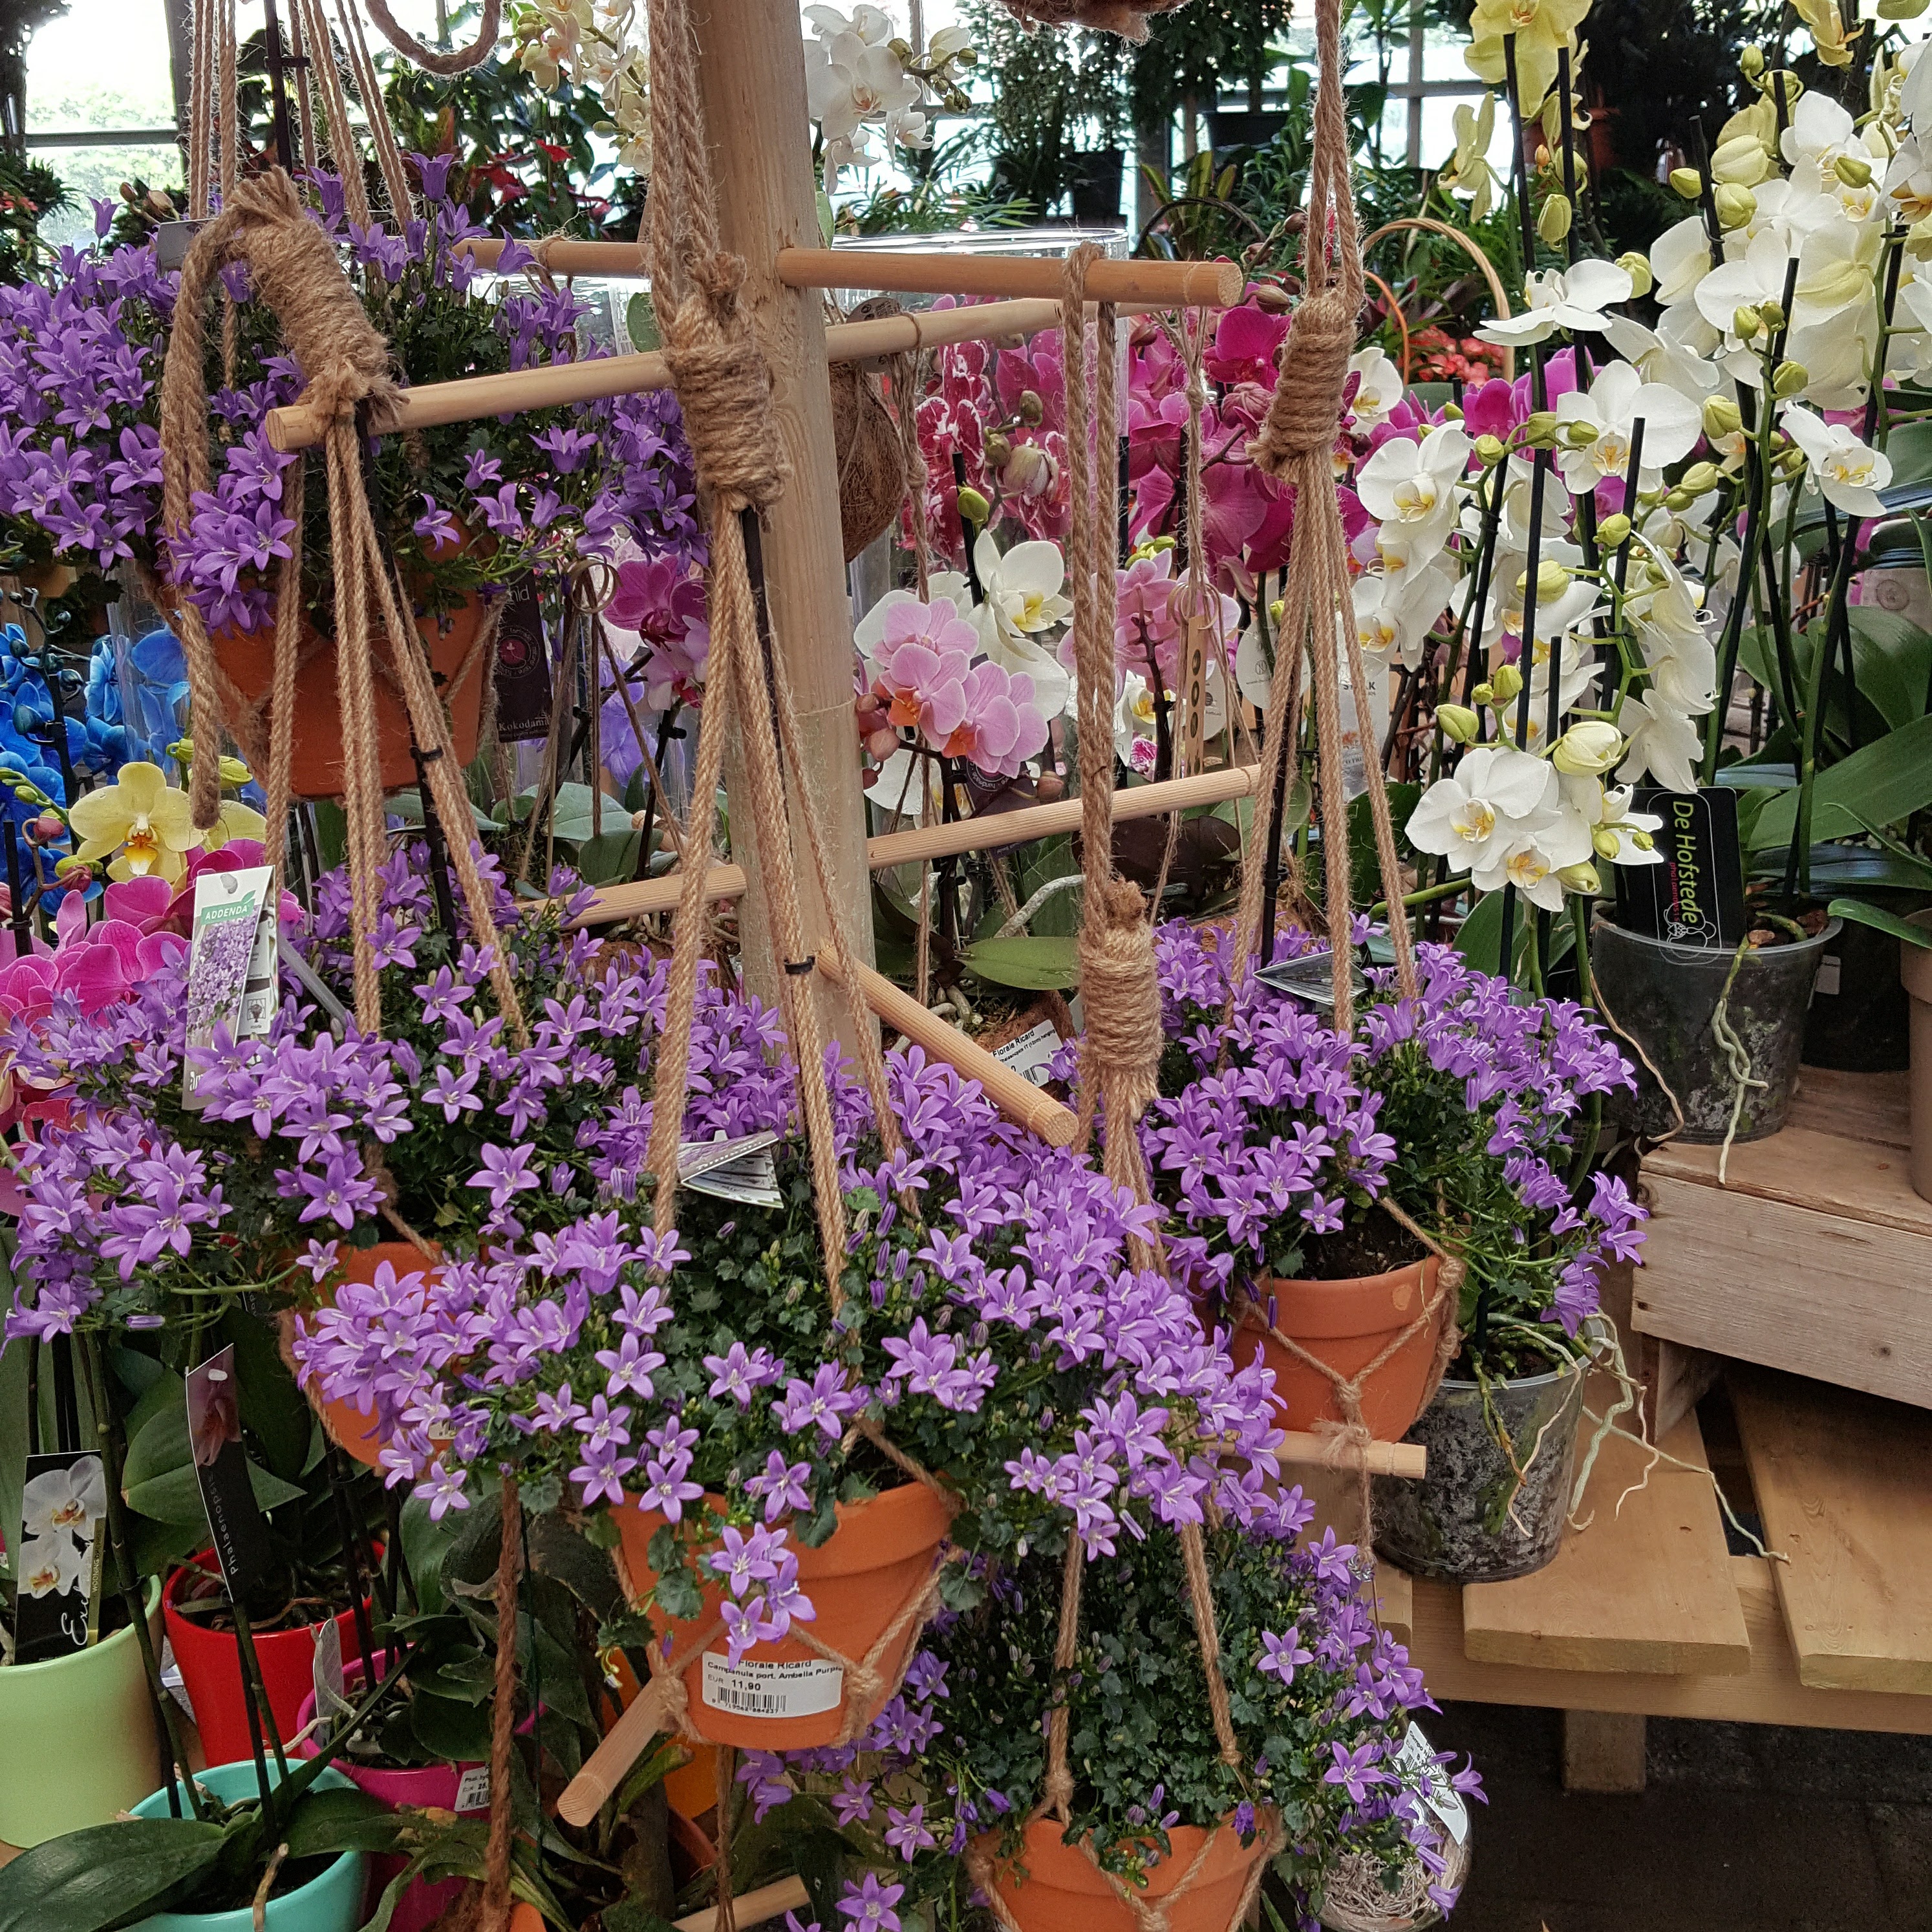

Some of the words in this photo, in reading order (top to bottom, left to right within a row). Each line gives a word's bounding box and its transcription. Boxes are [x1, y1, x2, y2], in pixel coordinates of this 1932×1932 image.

[1673, 802, 1694, 830] De
[1676, 833, 1702, 923] Hofstede
[1669, 862, 1680, 921] phalaenopsis
[206, 905, 248, 920] ADDENDA
[993, 1042, 1014, 1057] Florale
[1015, 1030, 1035, 1046] Ricard
[707, 1662, 753, 1677] Campanula
[778, 1670, 813, 1679] Ambella
[738, 1660, 774, 1669] Florale
[777, 1660, 811, 1669] Ricard
[708, 1674, 724, 1684] EUR
[731, 1679, 761, 1691] 11,90
